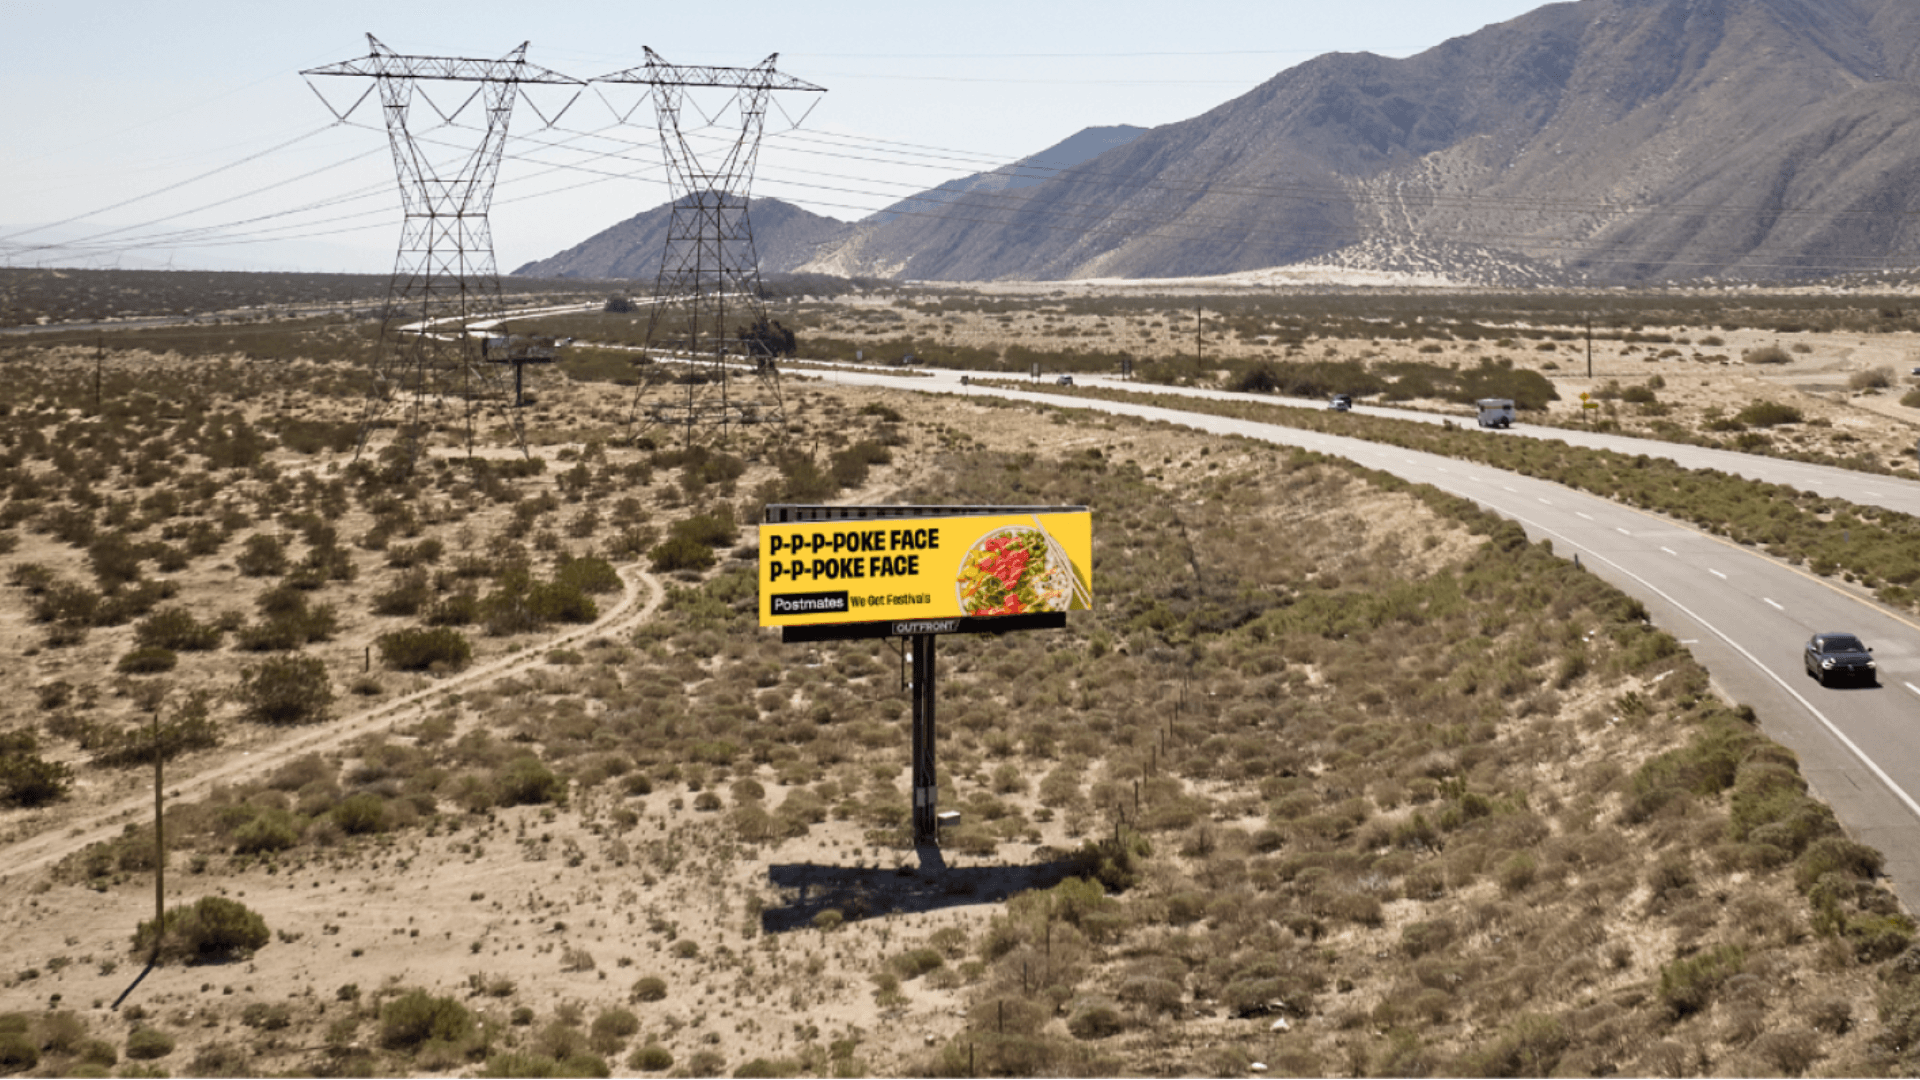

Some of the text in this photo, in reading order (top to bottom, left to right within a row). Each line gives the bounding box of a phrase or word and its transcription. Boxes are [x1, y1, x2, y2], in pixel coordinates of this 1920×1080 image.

[770, 528, 939, 555] P-P-P-POKE FACE
[770, 555, 919, 582] P-P-POKE FACE
[774, 596, 844, 611] Postmates
[850, 595, 866, 608] We
[887, 592, 931, 606] Festivals
